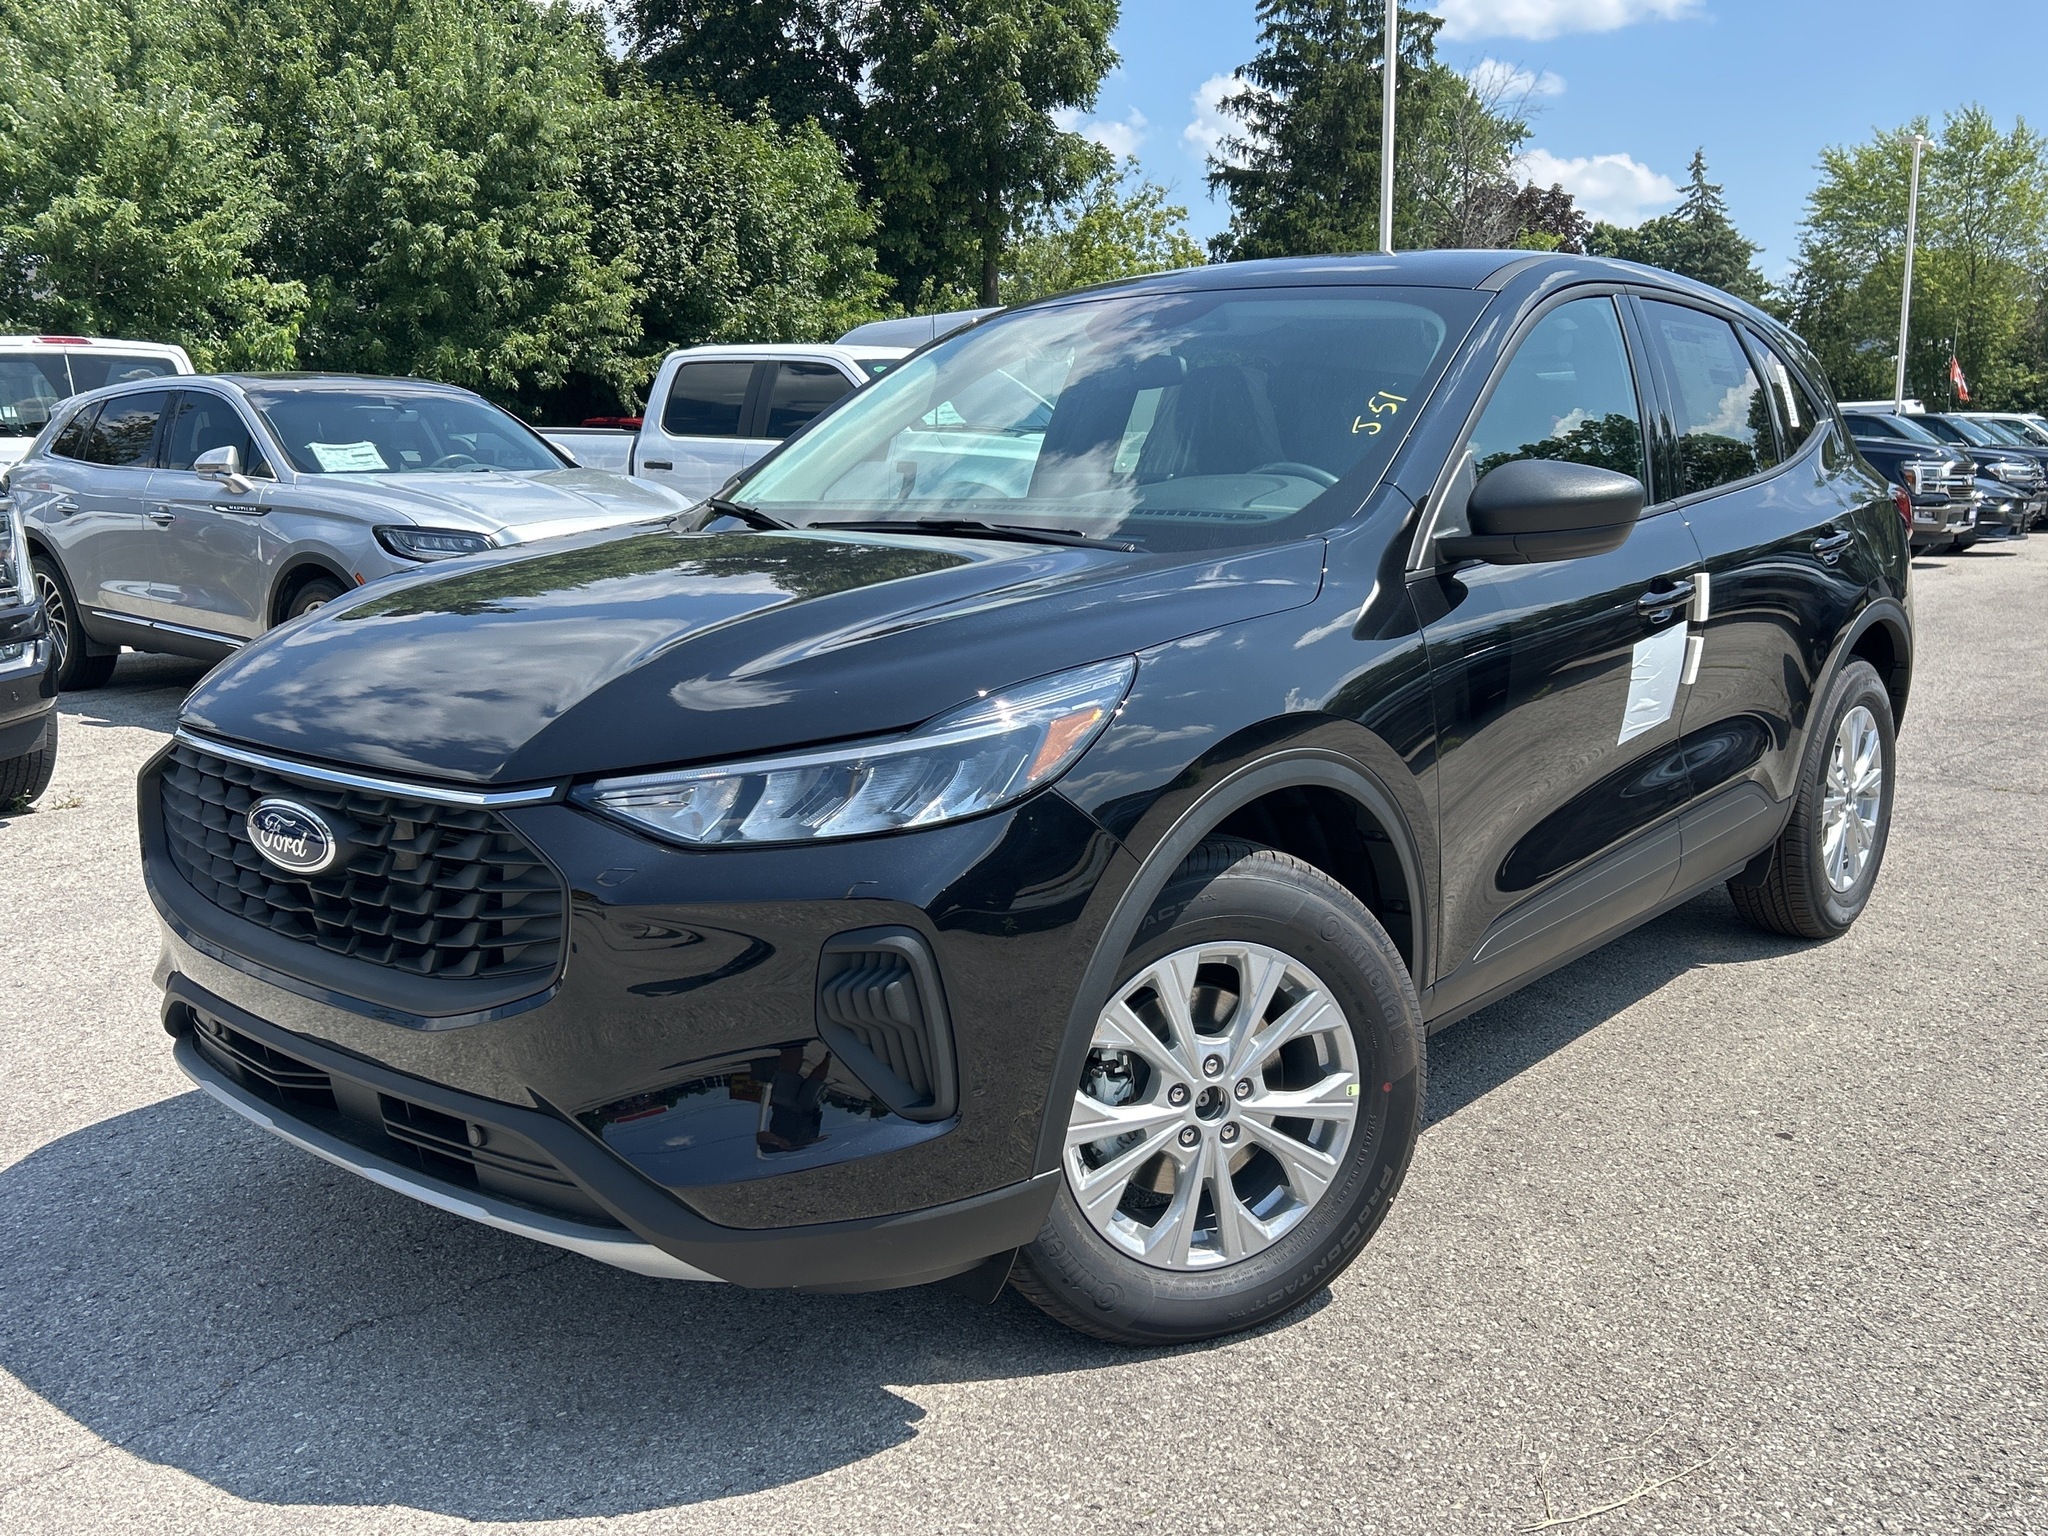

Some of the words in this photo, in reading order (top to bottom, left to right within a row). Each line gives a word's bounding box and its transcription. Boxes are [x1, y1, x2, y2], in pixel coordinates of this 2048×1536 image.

[260, 813, 308, 858] Ford
[1316, 909, 1407, 1032] Continental
[1037, 1215, 1126, 1314] Continen
